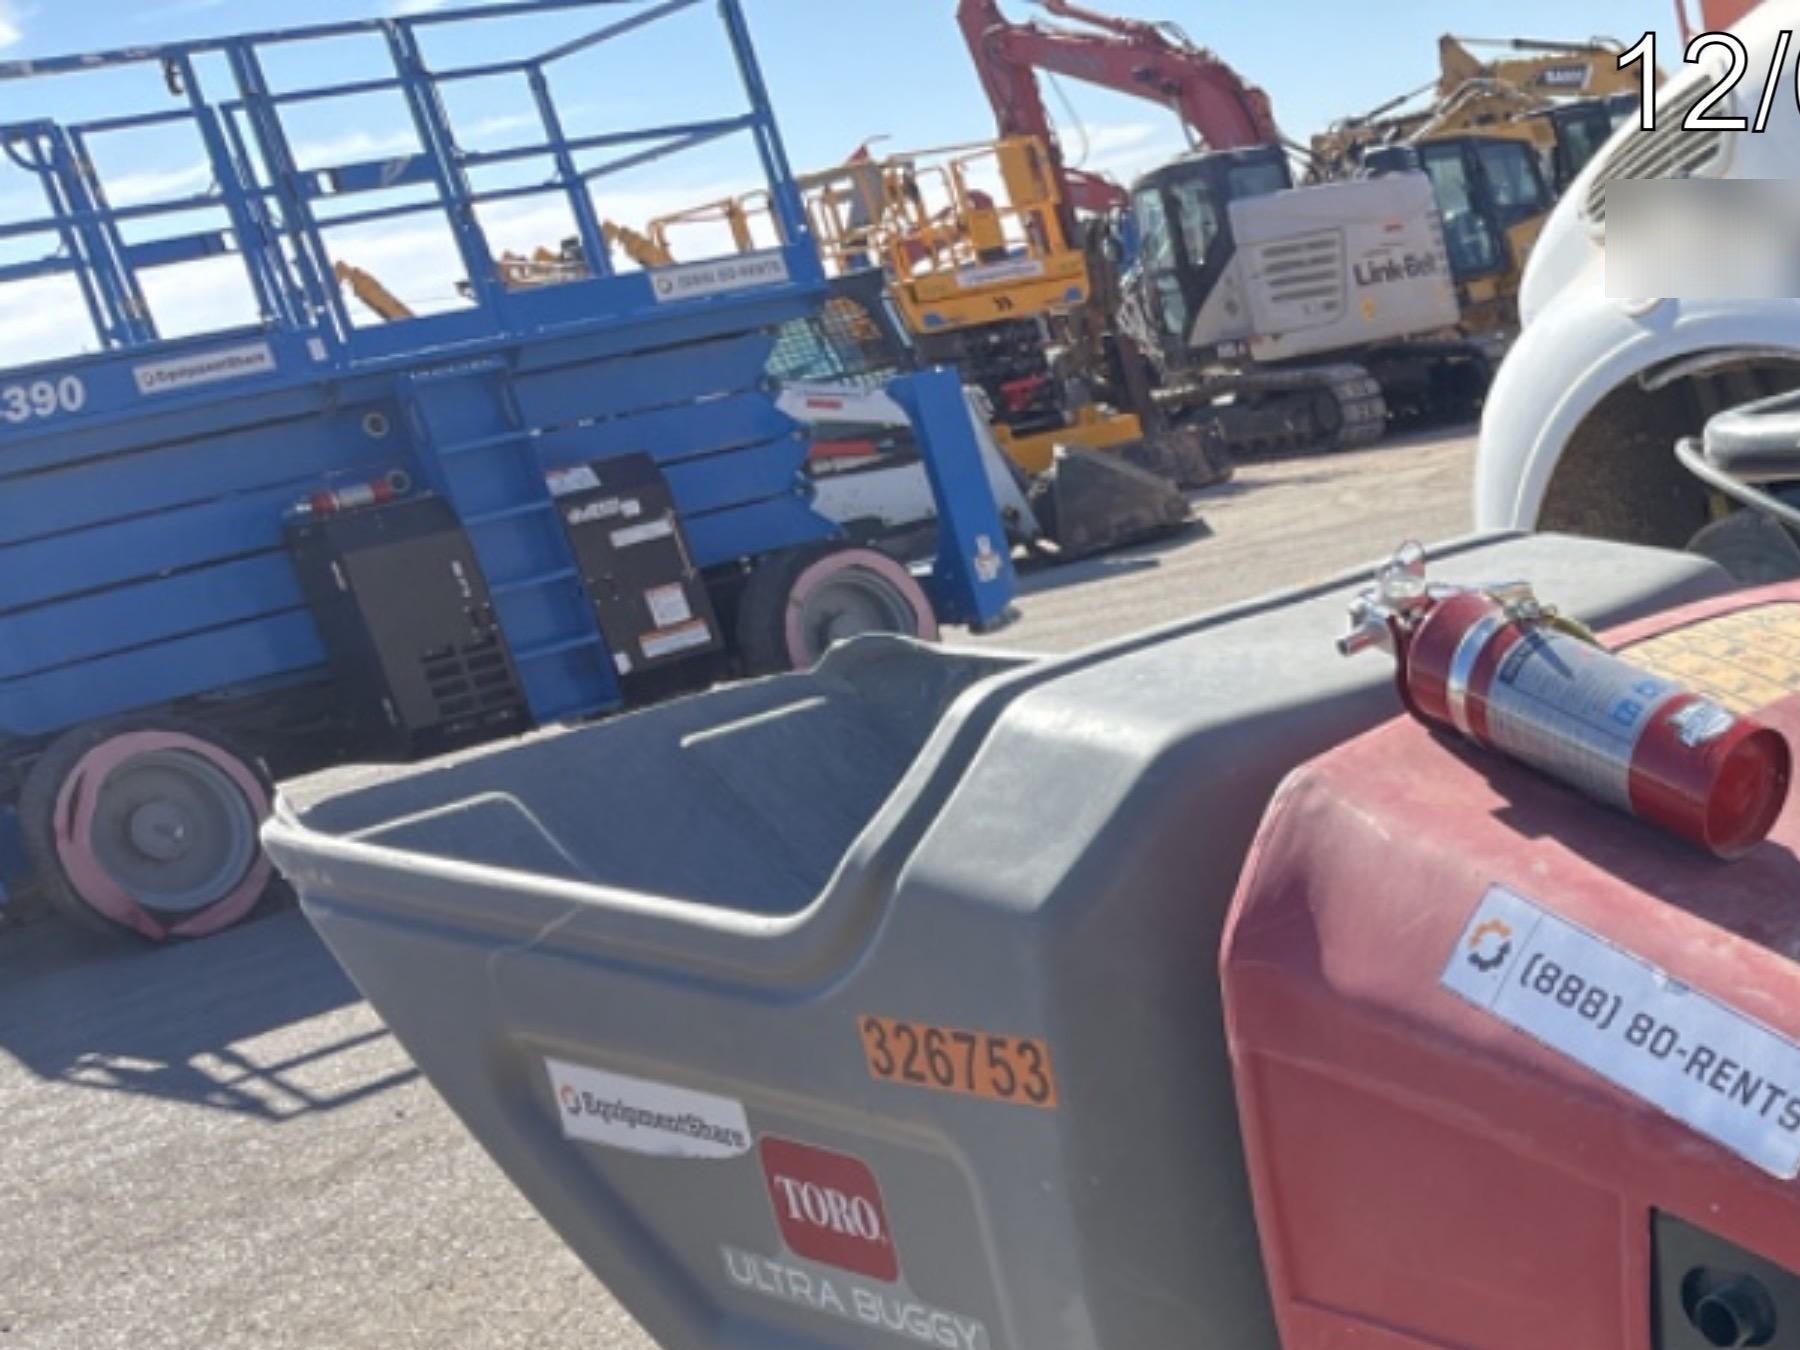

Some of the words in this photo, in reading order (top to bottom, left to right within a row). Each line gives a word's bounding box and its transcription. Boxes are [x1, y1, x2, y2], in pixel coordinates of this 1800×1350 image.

[1518, 952, 1623, 1031] (888)
[862, 1016, 1053, 1104] 326753
[582, 1090, 746, 1148] EquipmentShare
[773, 1174, 882, 1241] TORO
[720, 1243, 847, 1314] ULTRA
